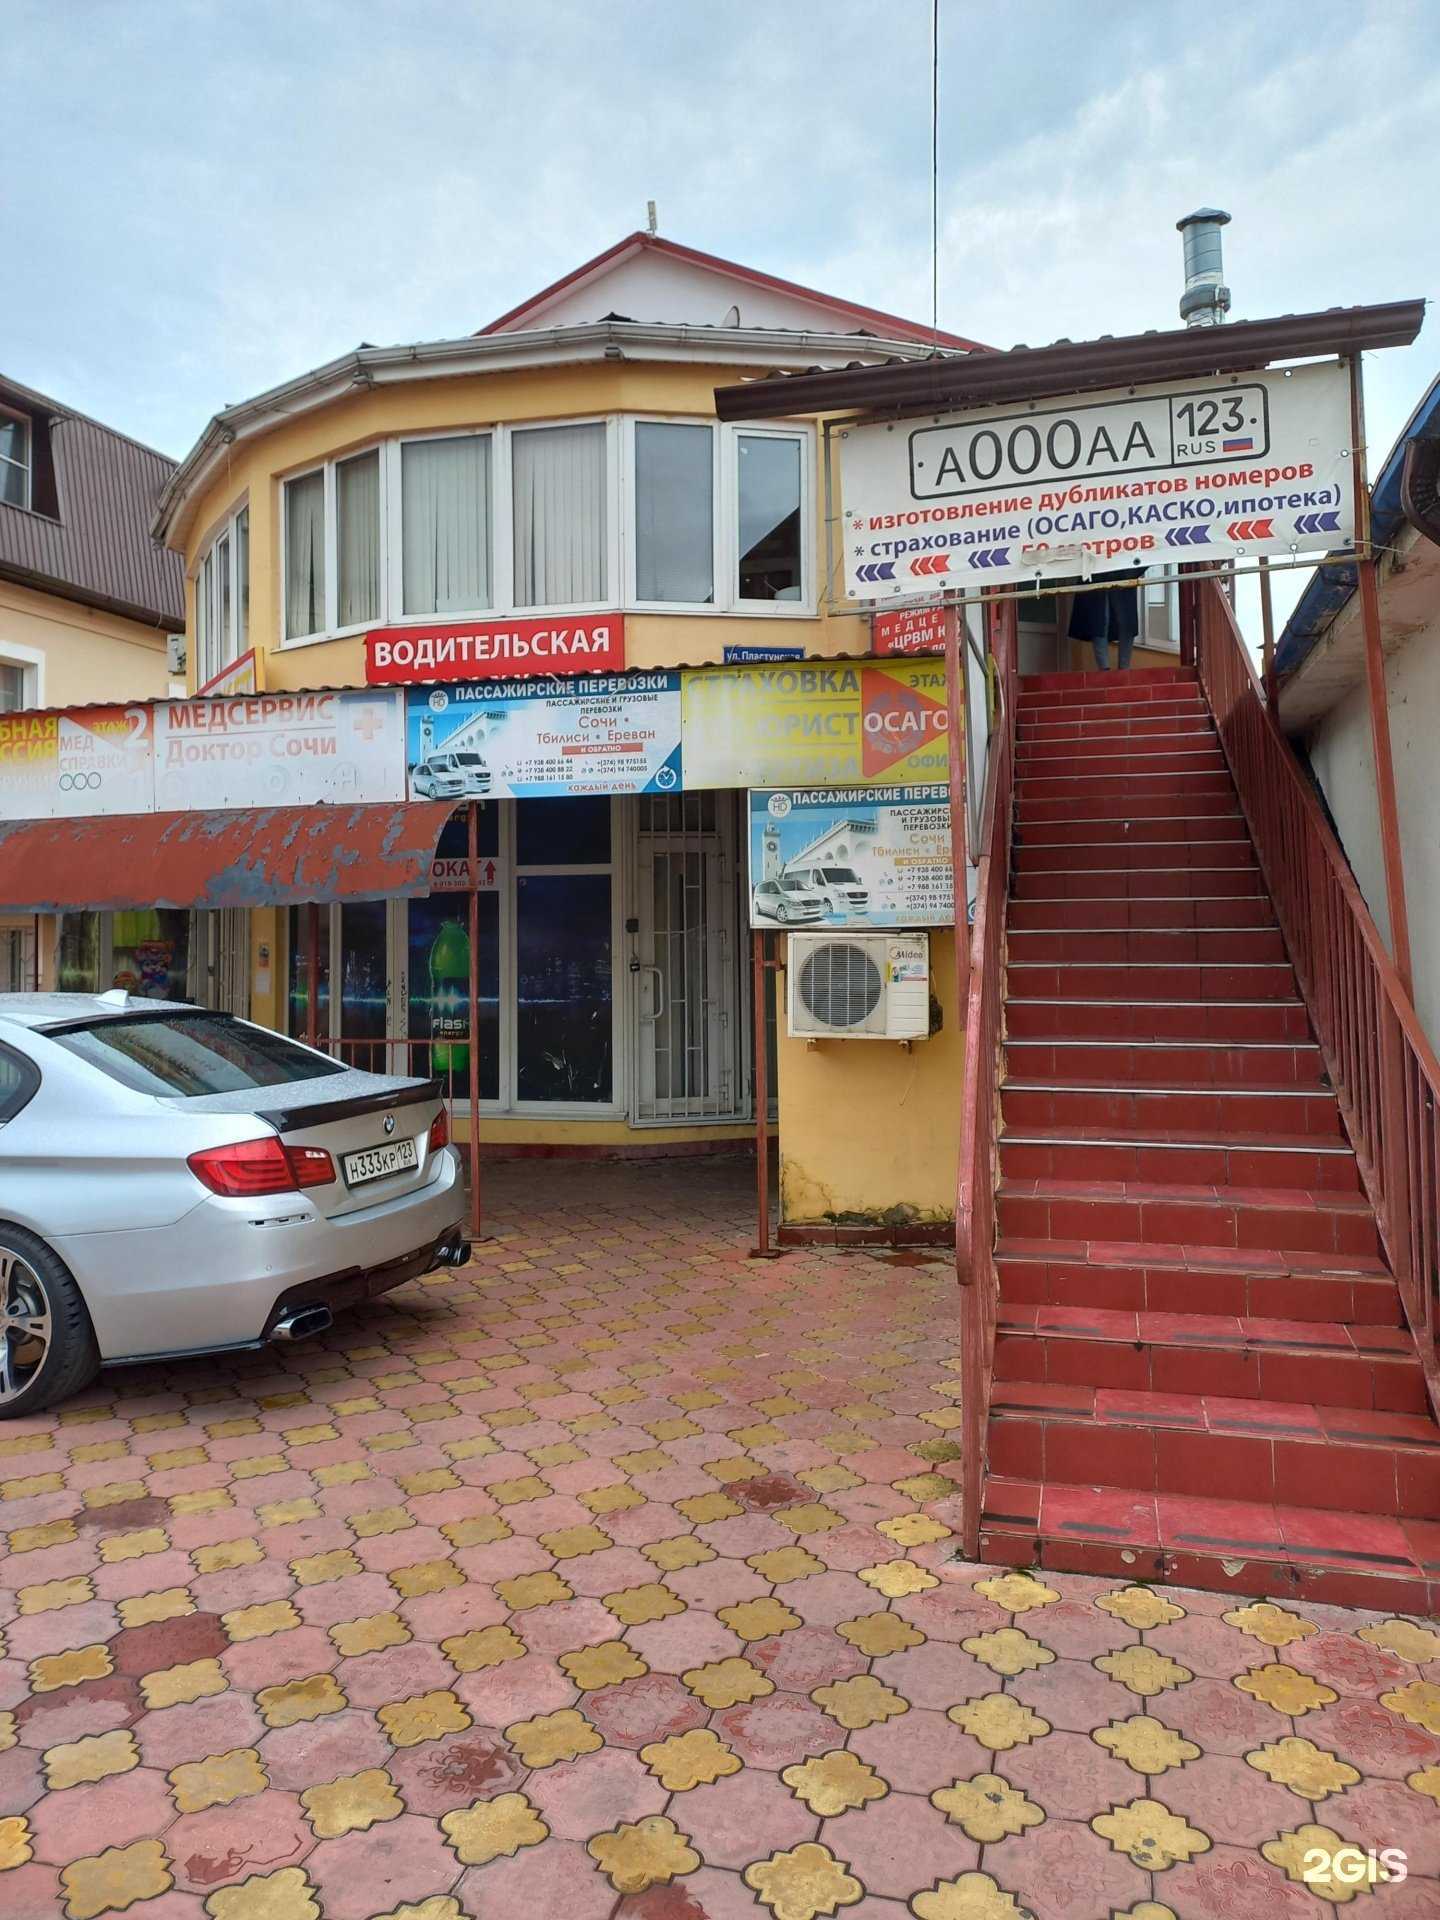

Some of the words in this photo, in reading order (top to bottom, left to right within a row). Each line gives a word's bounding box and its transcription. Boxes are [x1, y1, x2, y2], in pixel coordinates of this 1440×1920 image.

[1177, 396, 1245, 437] 123
[1176, 441, 1216, 458] RUS
[869, 495, 1032, 531] изготовление
[1038, 477, 1189, 512] дубликатов
[1195, 463, 1314, 490] номеров
[870, 523, 1021, 558] страхование
[375, 627, 610, 670] ВОДИТЕЛЬСКАЯ
[455, 681, 575, 701] ПАССАЖИРСКИЕ
[578, 675, 668, 694] ПЕРЕВОЗКИ
[546, 696, 611, 708] ПАССАЖИРСКИЕ
[619, 694, 658, 702] ГРУЗОВЫЕ
[580, 706, 622, 715] ПЕРЕВОЗКИ
[168, 695, 334, 732] МЕДСЕРВИС
[578, 715, 617, 729] Сочи
[863, 709, 948, 733] ОСАГО
[0, 717, 57, 741] БНАЯ
[123, 709, 149, 749] 2
[537, 732, 590, 745] Тбилиси
[607, 729, 656, 743] Ереван
[60, 735, 95, 752] МЕД
[165, 738, 261, 768] Доктор
[271, 733, 336, 757] Сочи
[793, 788, 901, 806] ПАССАЖИРСКИЕ
[905, 785, 951, 799] ПЕРЕВ
[910, 833, 945, 845] Сочи
[872, 846, 920, 857] Тбилиси
[432, 860, 482, 877] ОКА
[397, 1142, 413, 1161] 123
